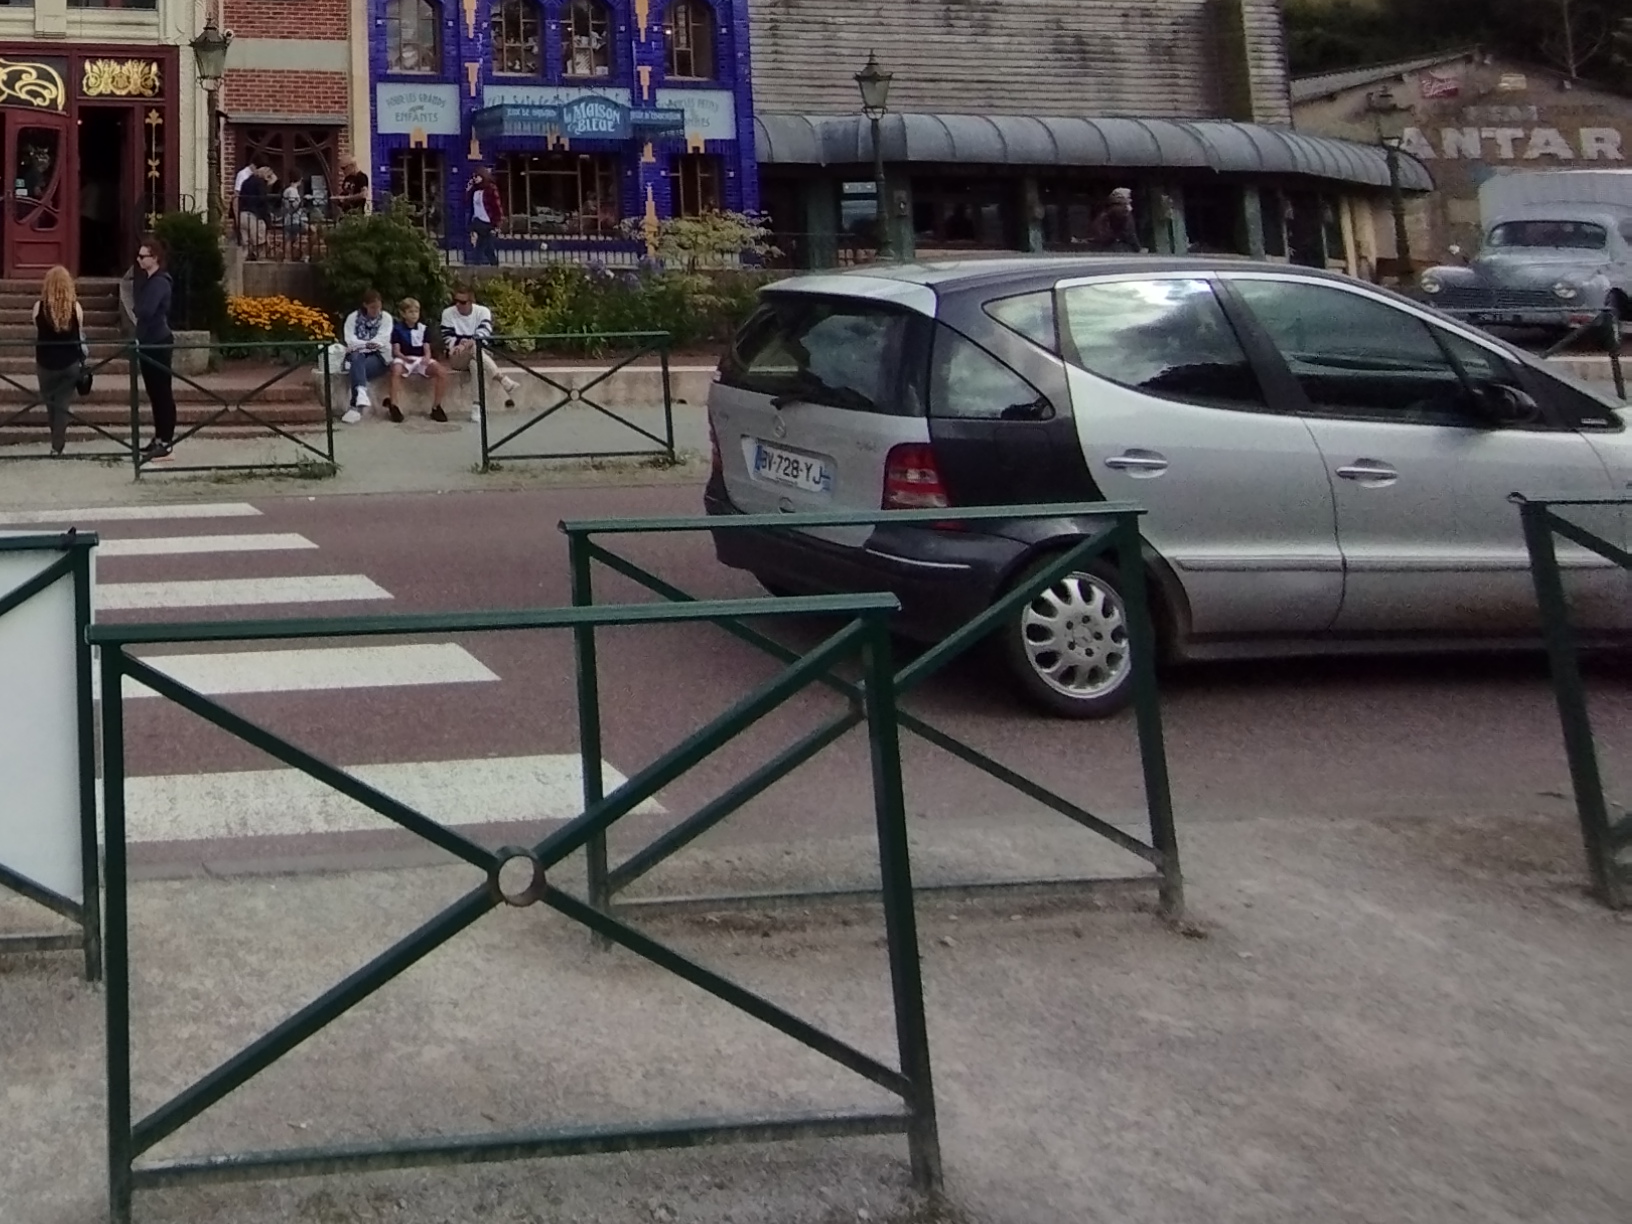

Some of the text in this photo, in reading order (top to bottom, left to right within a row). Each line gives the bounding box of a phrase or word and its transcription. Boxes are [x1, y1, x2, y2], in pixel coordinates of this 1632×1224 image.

[394, 112, 439, 123] ENFANTS
[573, 101, 620, 124] MAISON
[576, 118, 615, 134] BLEUE
[1400, 127, 1626, 161] ANTAR
